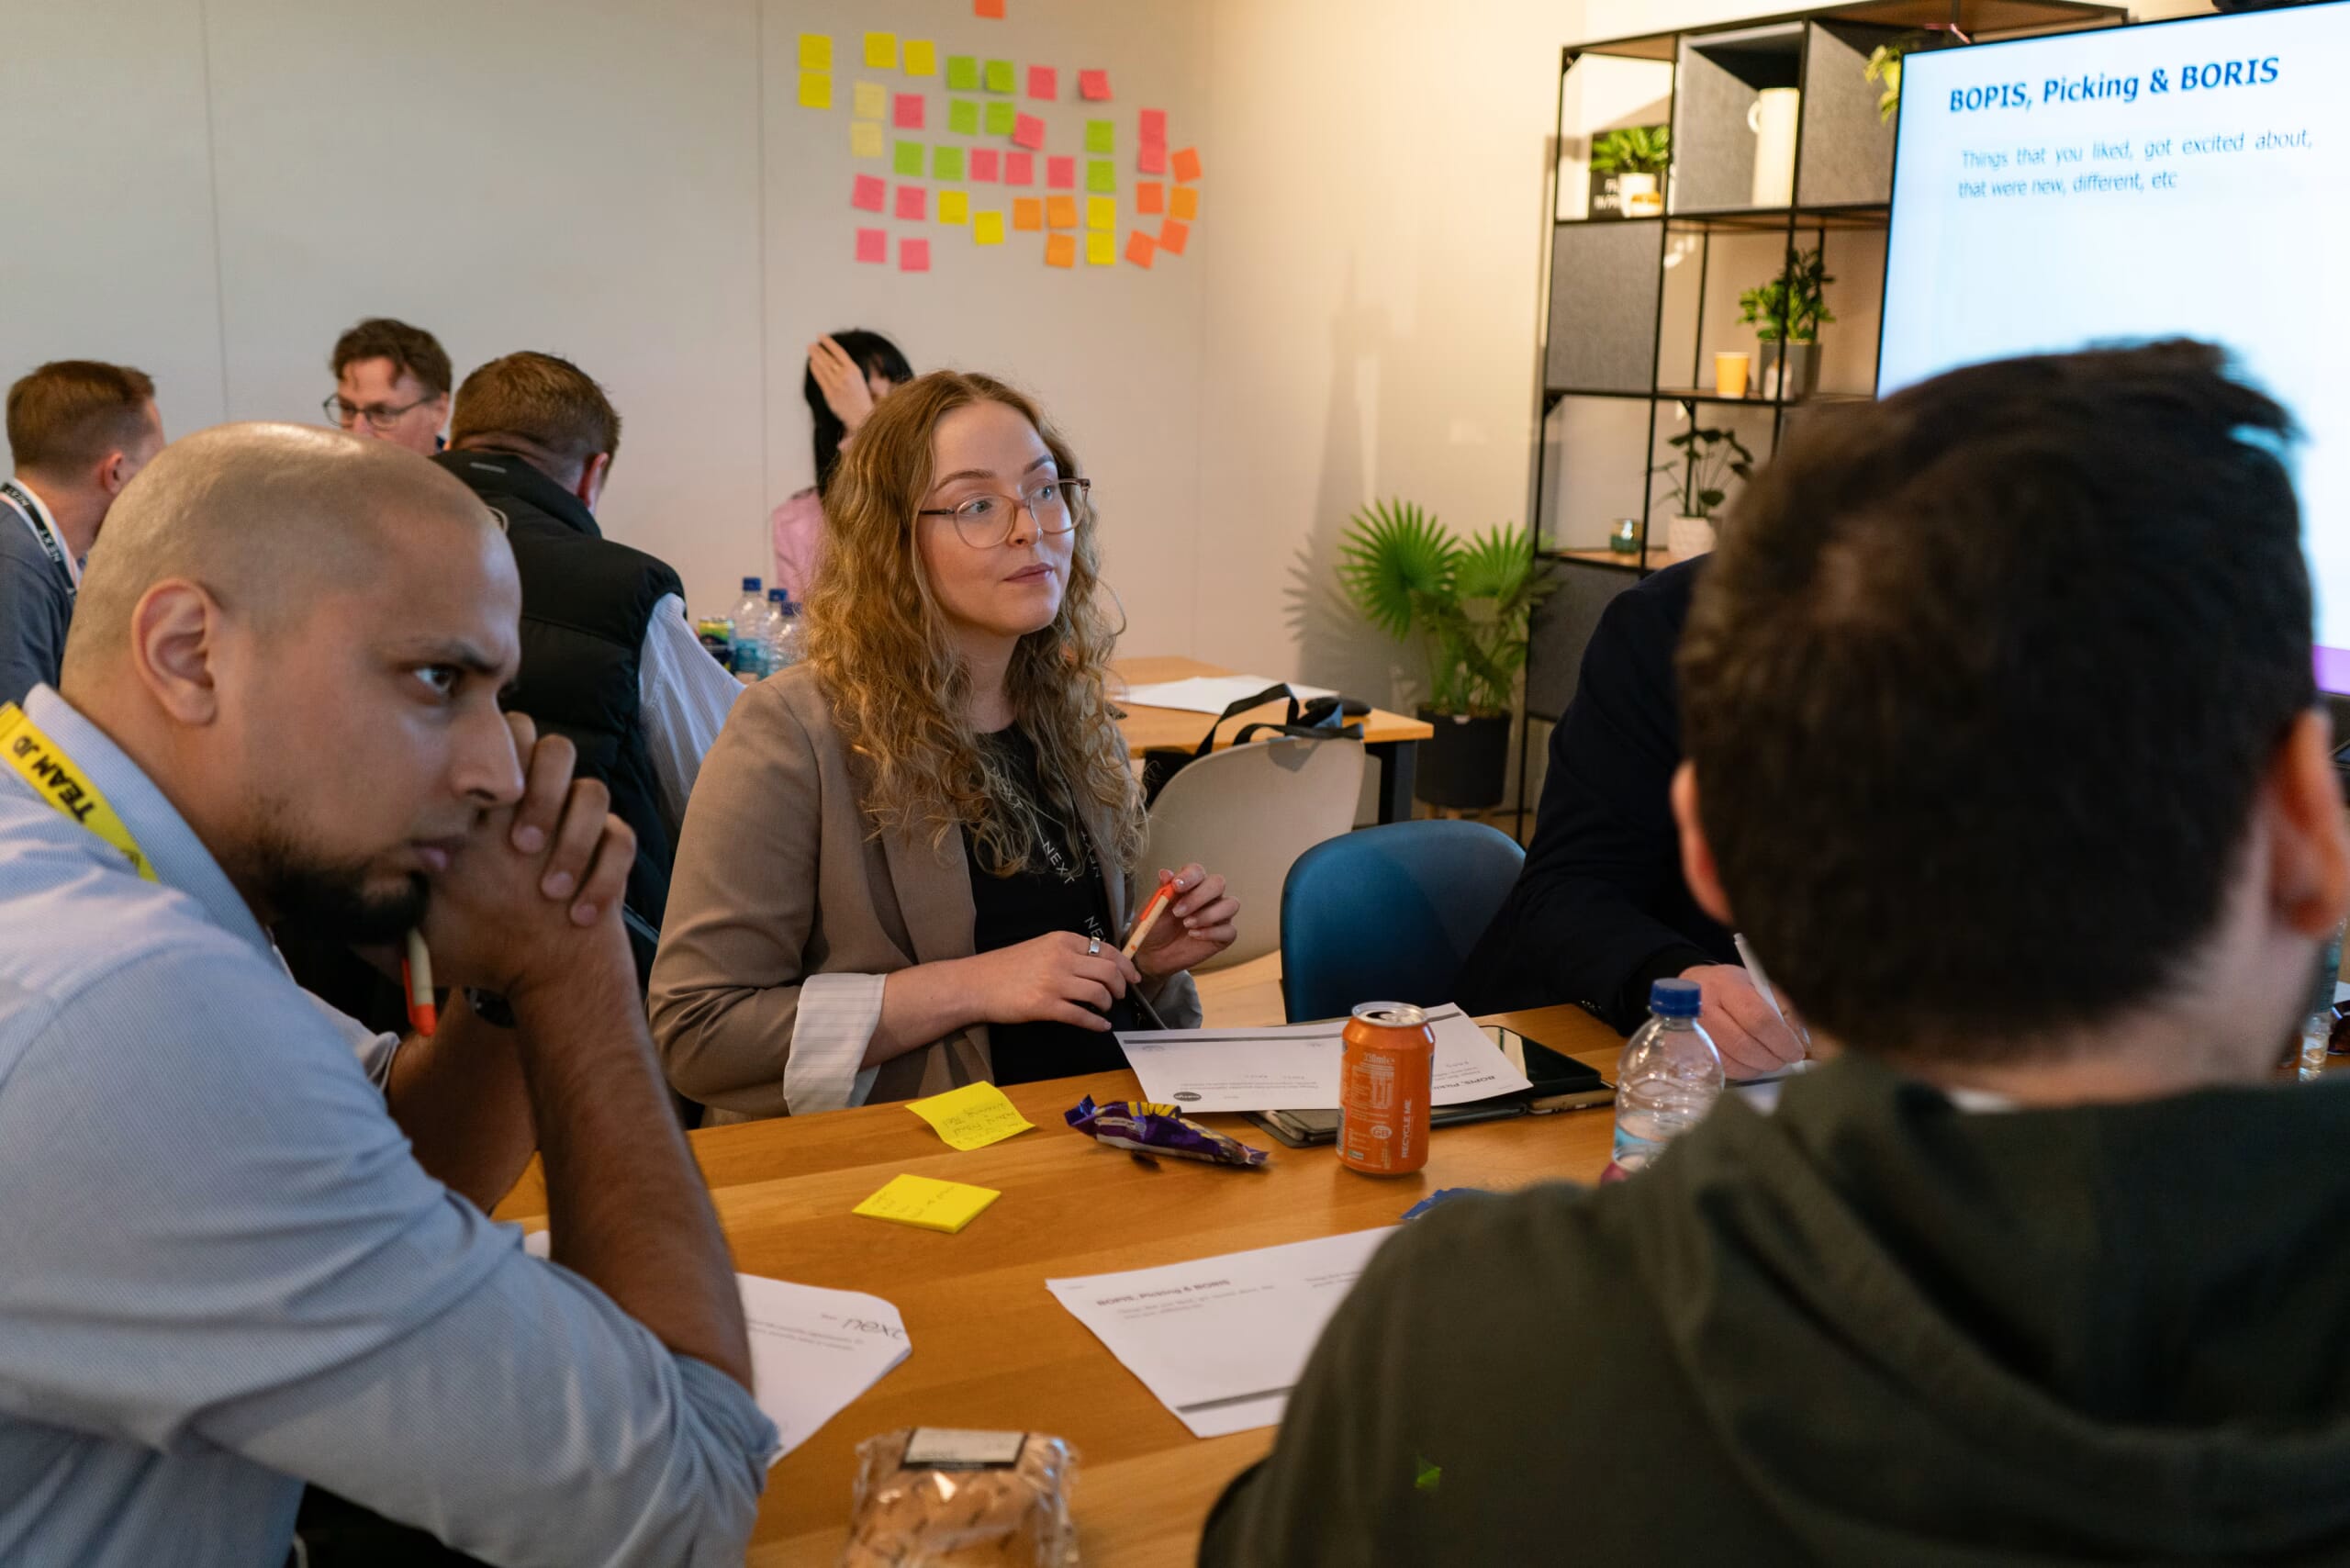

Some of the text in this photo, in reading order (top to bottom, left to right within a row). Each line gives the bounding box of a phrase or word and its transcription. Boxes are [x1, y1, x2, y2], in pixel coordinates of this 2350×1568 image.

[1950, 56, 2280, 113] BOPIS, Picking & BORIS
[1962, 129, 2312, 171] Things that you liked, got excited about,
[1958, 171, 2178, 198] that were new, different, etc
[31, 754, 95, 823] TEAM
[1043, 840, 1075, 884] NEXT
[1401, 1098, 1412, 1159] RECYCLE ME
